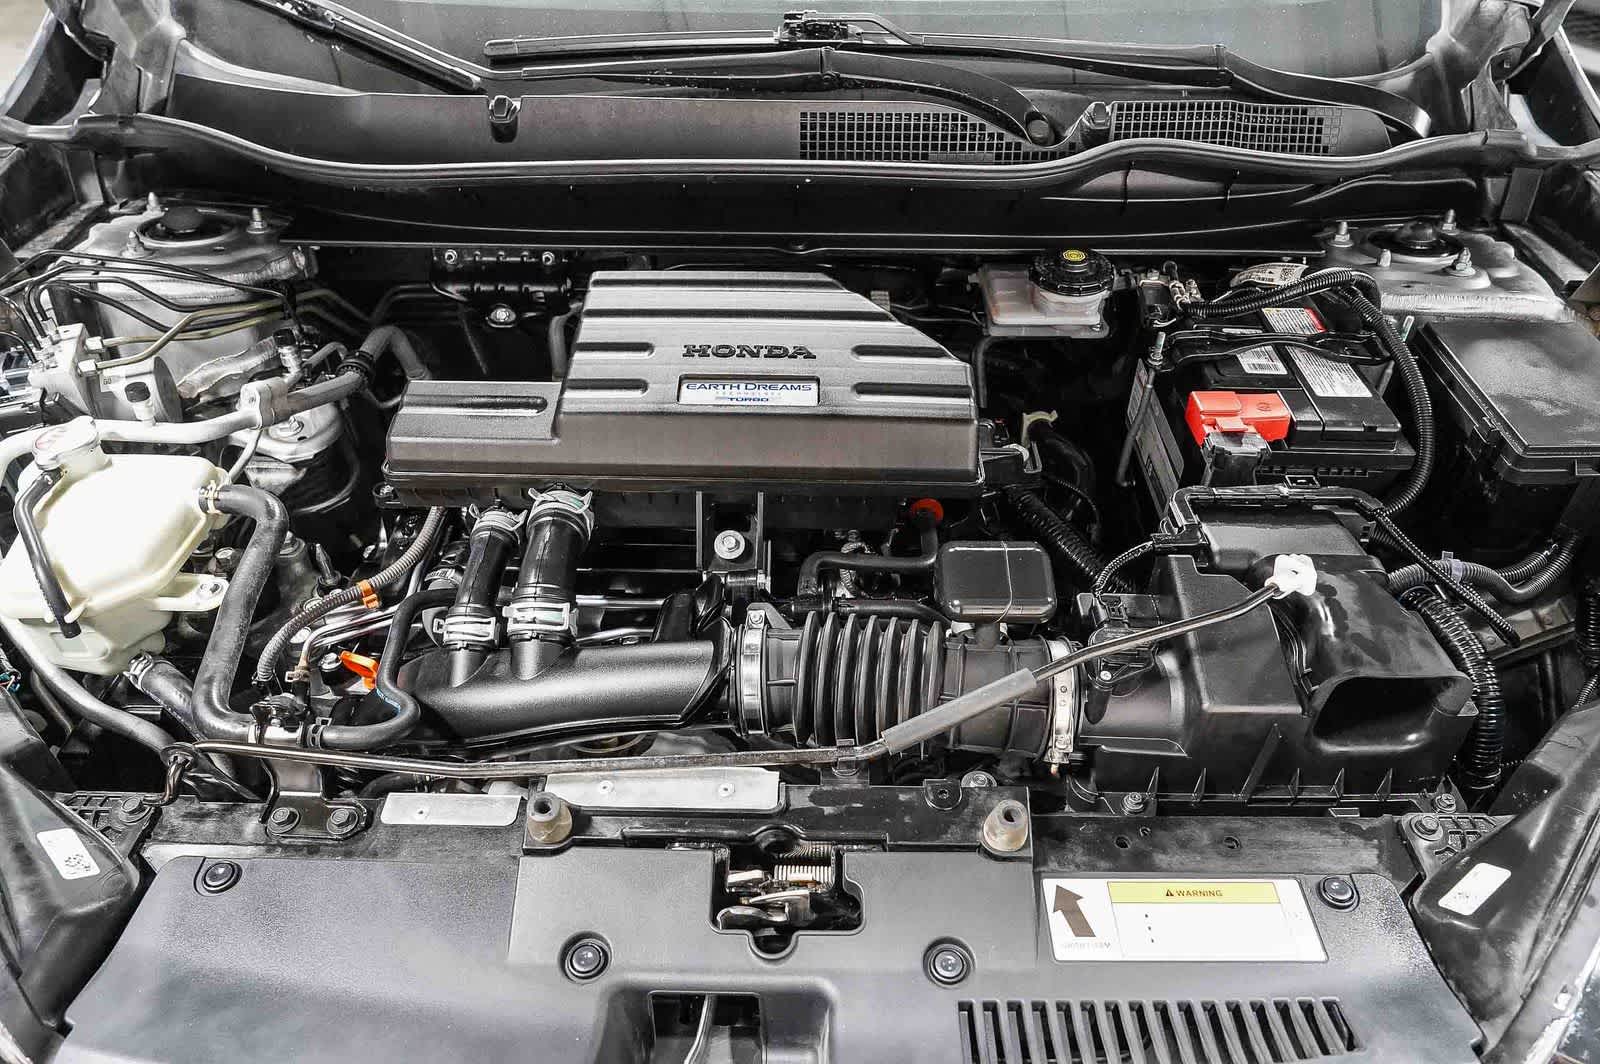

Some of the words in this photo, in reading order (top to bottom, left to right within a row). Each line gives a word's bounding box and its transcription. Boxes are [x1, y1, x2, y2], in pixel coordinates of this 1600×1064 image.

[682, 344, 817, 359] HONDA
[686, 383, 740, 391] EARTH
[745, 382, 812, 391] DREAMS
[1176, 889, 1223, 897] WARNING
